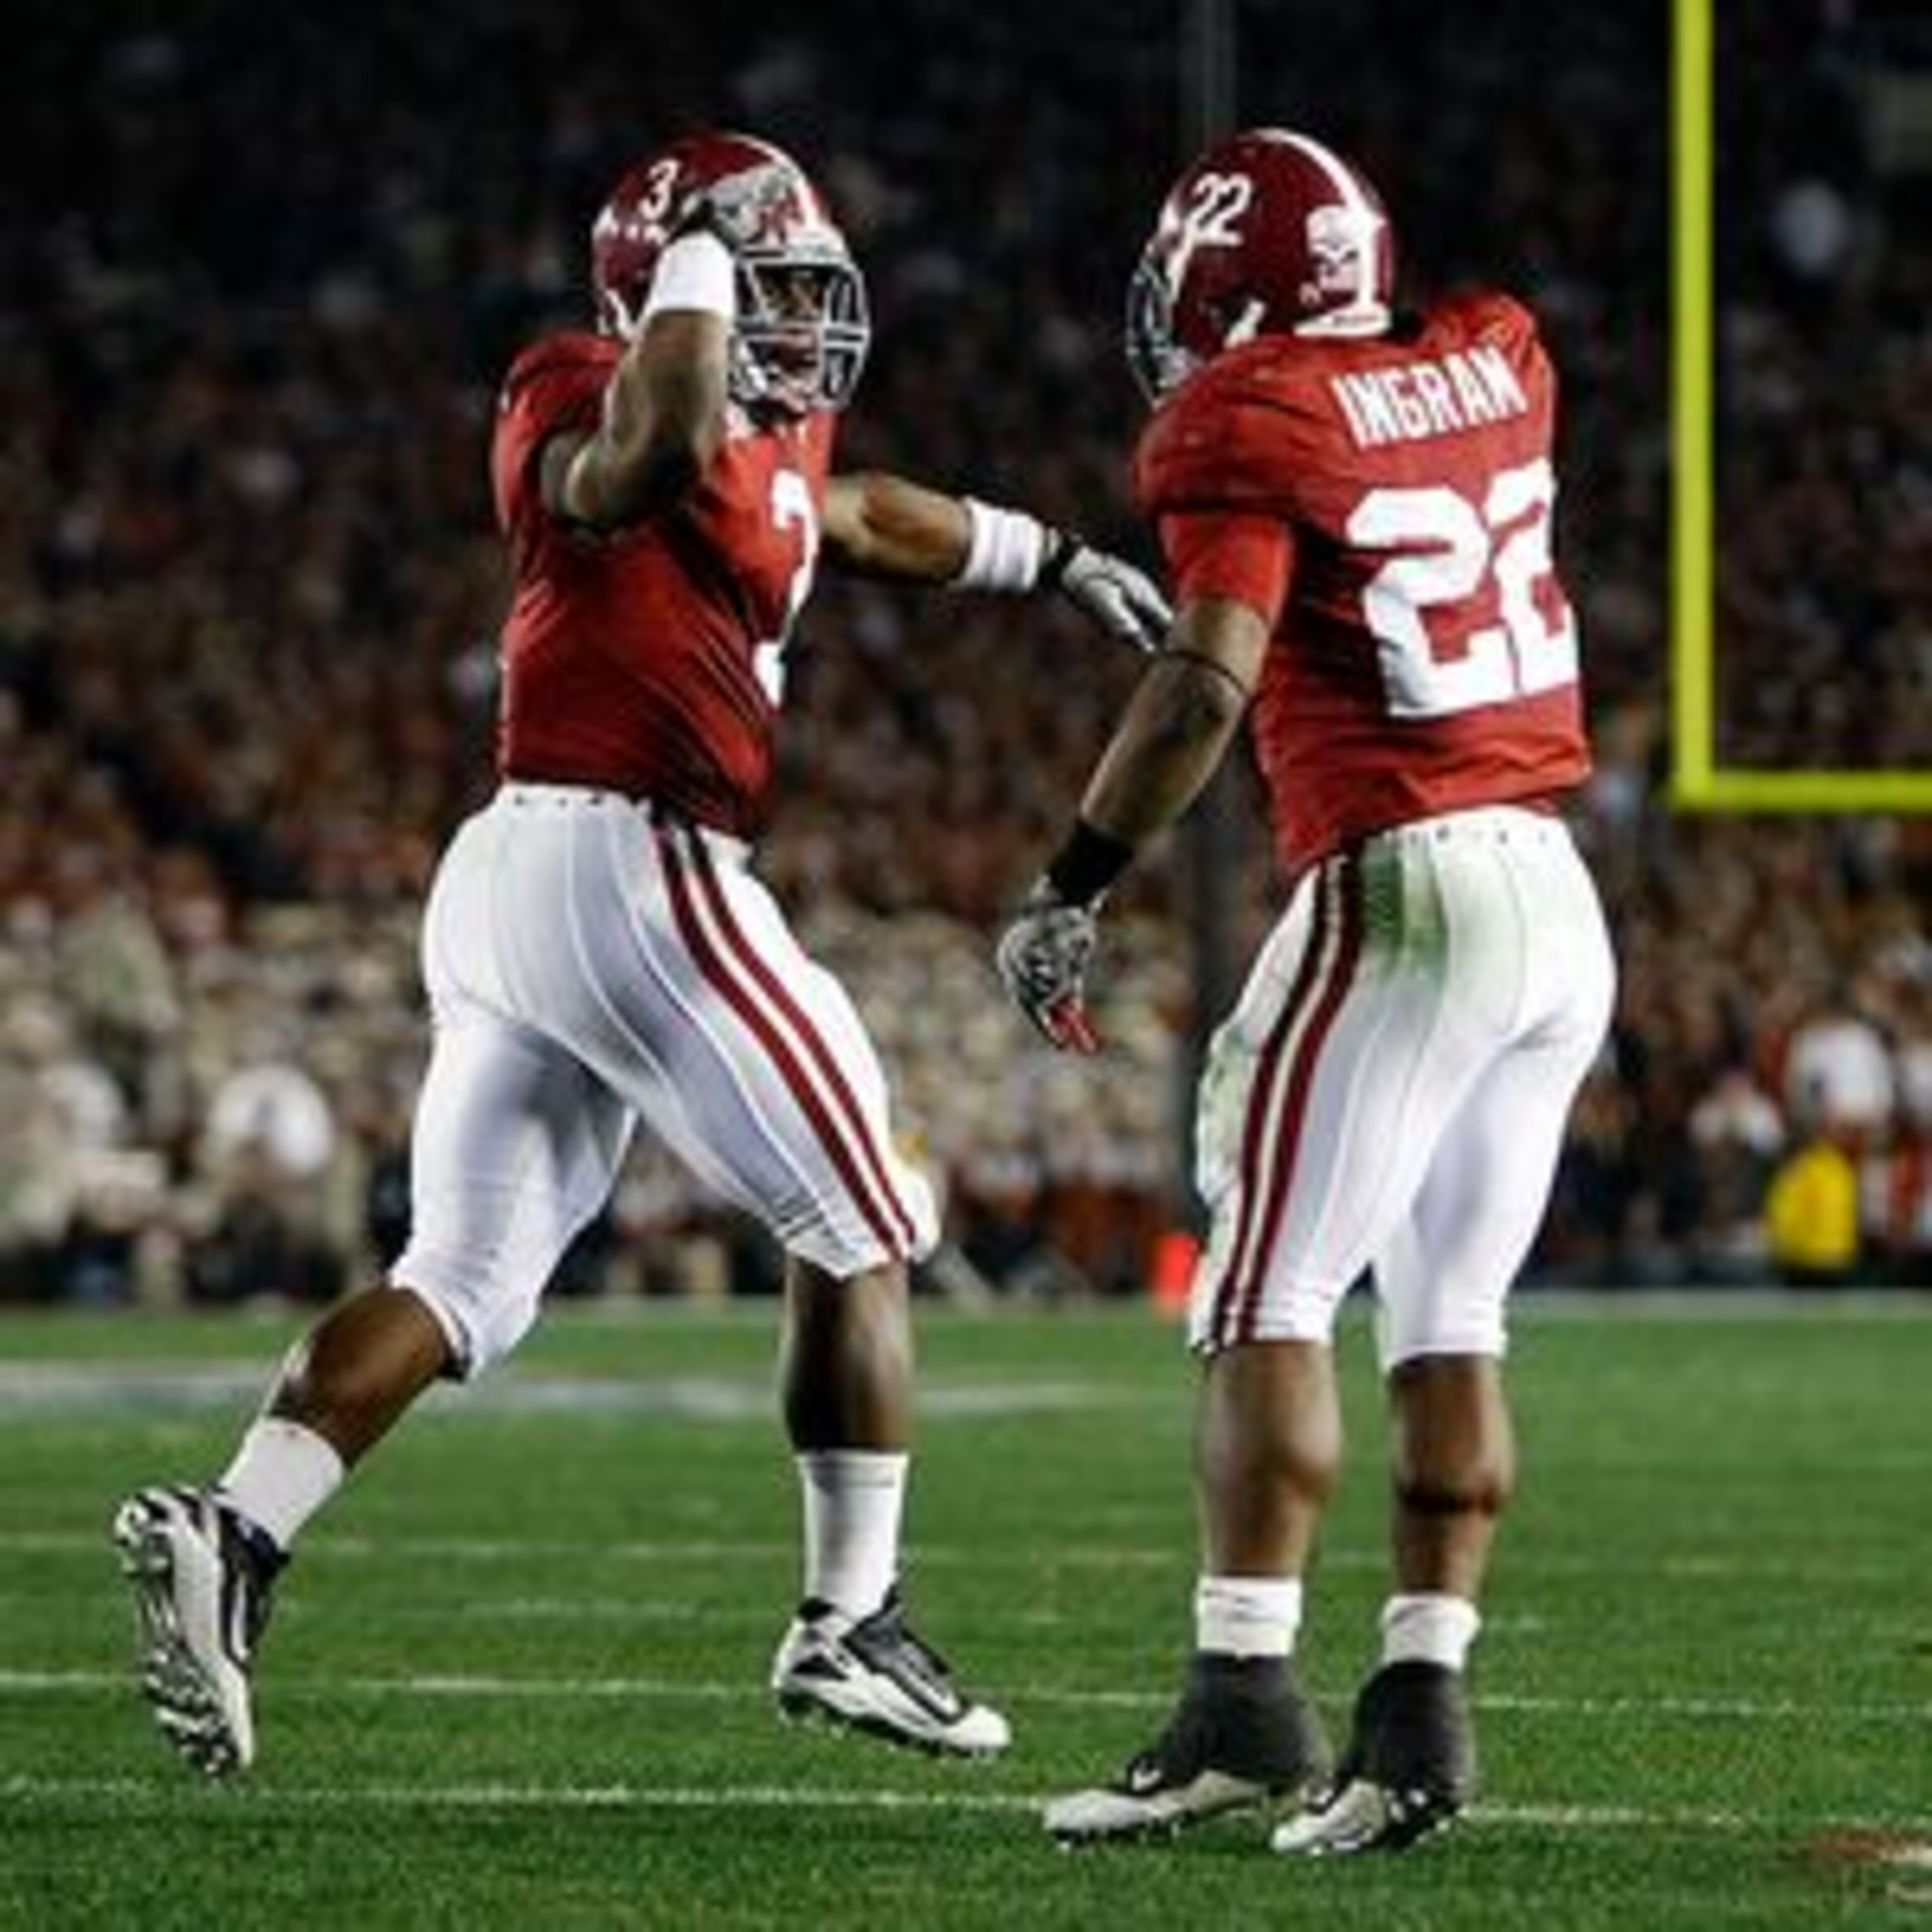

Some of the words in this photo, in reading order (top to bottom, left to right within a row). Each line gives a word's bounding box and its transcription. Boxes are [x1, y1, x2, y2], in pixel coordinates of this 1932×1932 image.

[639, 158, 681, 221] 3
[1185, 173, 1253, 247] 22
[1345, 455, 1581, 719] 22
